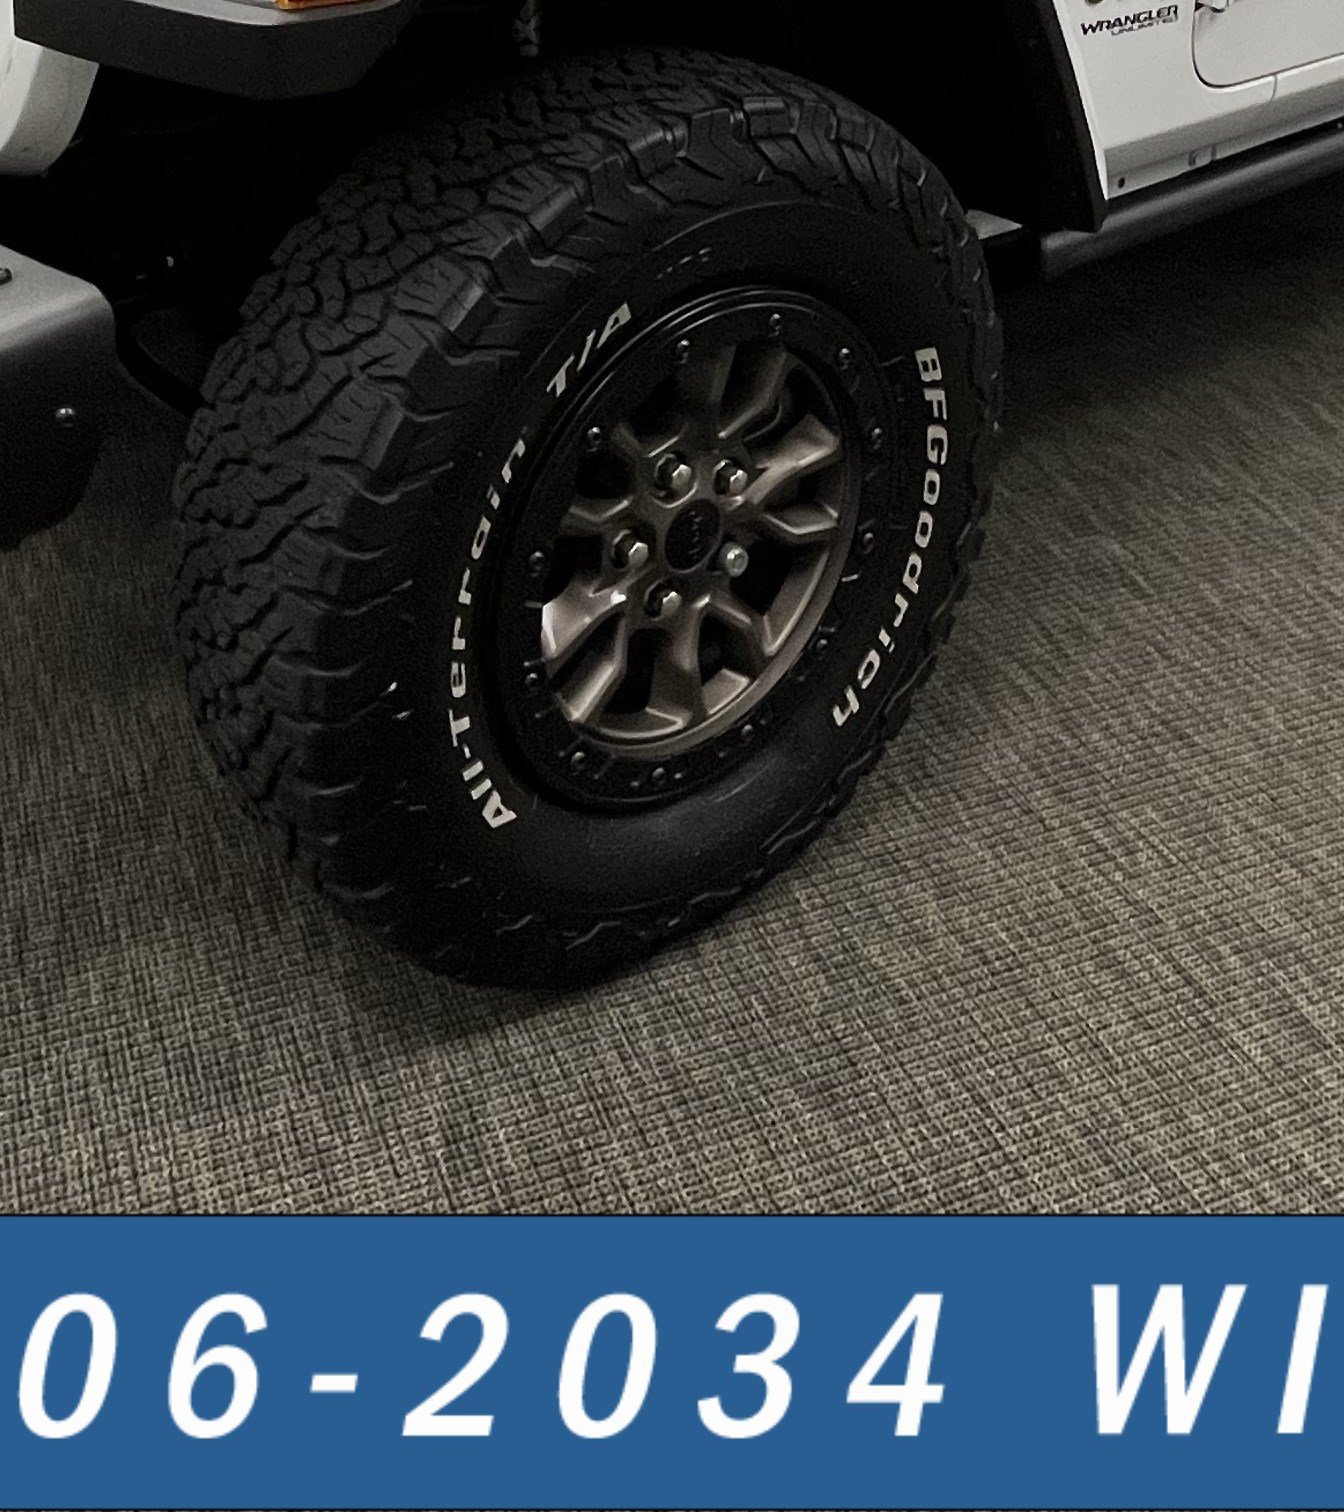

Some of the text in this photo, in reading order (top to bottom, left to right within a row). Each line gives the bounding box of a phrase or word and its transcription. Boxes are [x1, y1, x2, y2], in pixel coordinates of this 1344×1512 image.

[1080, 4, 1179, 36] WRANGLER
[546, 302, 632, 398] T/A
[448, 436, 529, 829] All-Terrain
[832, 347, 949, 726] BFGoodrich
